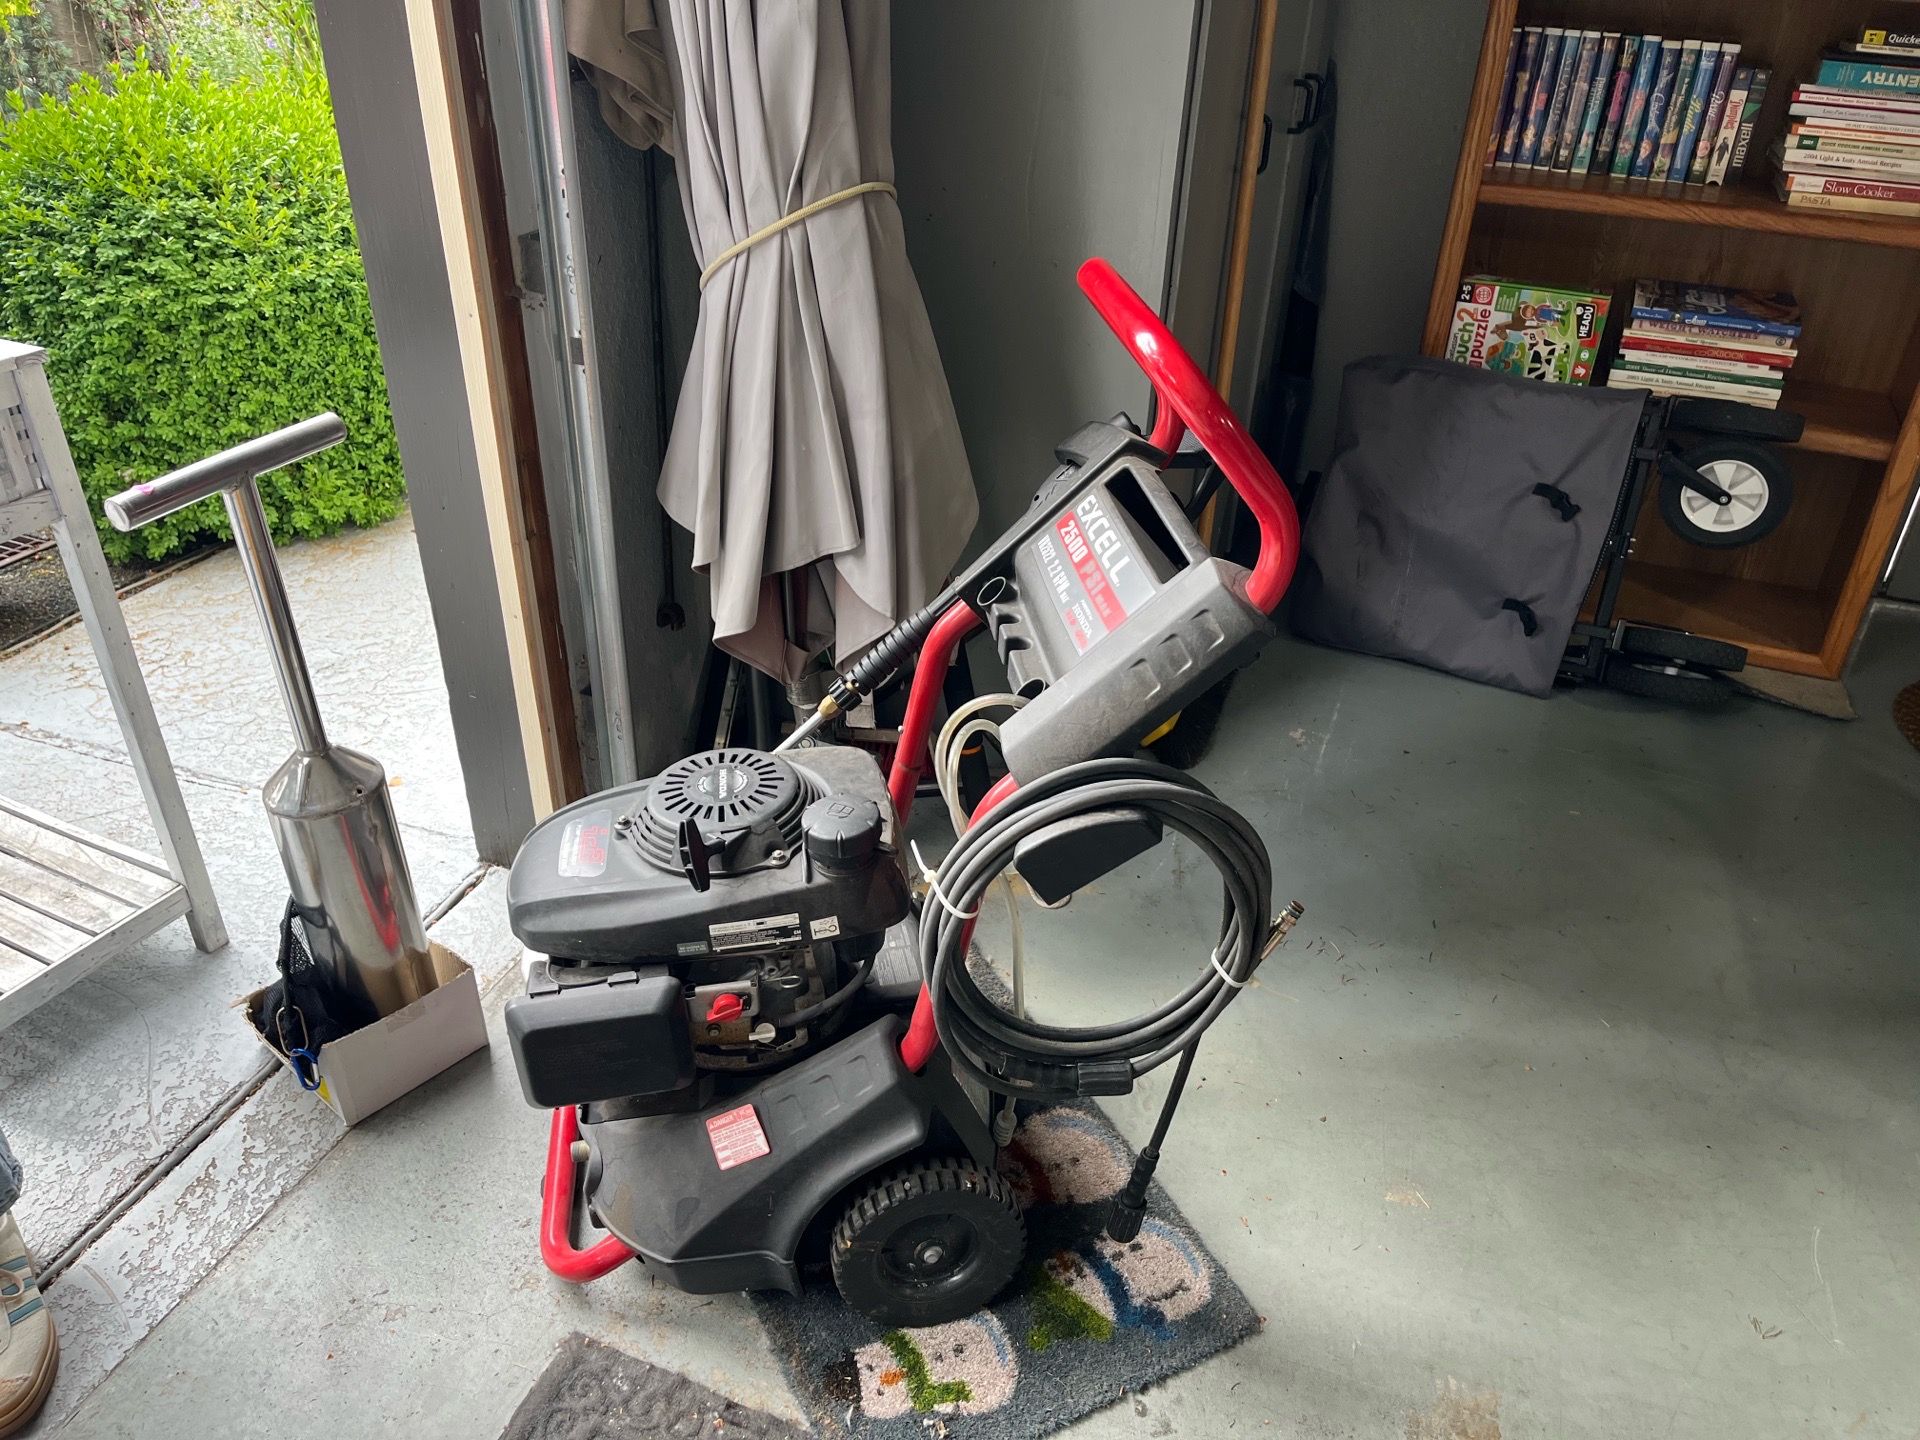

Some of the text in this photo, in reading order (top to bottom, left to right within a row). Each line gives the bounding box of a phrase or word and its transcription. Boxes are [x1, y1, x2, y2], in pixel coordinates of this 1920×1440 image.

[1553, 57, 1573, 121] ATLANTIS
[1732, 122, 1754, 168] maxell
[1857, 158, 1878, 166] Annual
[1800, 195, 1831, 207] PASTA
[1824, 181, 1852, 194] Slow
[1853, 184, 1896, 199] Cooker
[1460, 284, 1472, 300] 2-5
[1470, 308, 1491, 360] puzzle
[1578, 305, 1594, 337] HEADU
[1076, 494, 1131, 587] EXCELL
[1060, 519, 1089, 564] 2500
[1080, 560, 1106, 595] PSI
[1052, 571, 1071, 598] GPM
[1072, 603, 1093, 638] HONDA
[719, 768, 728, 799] HONDA
